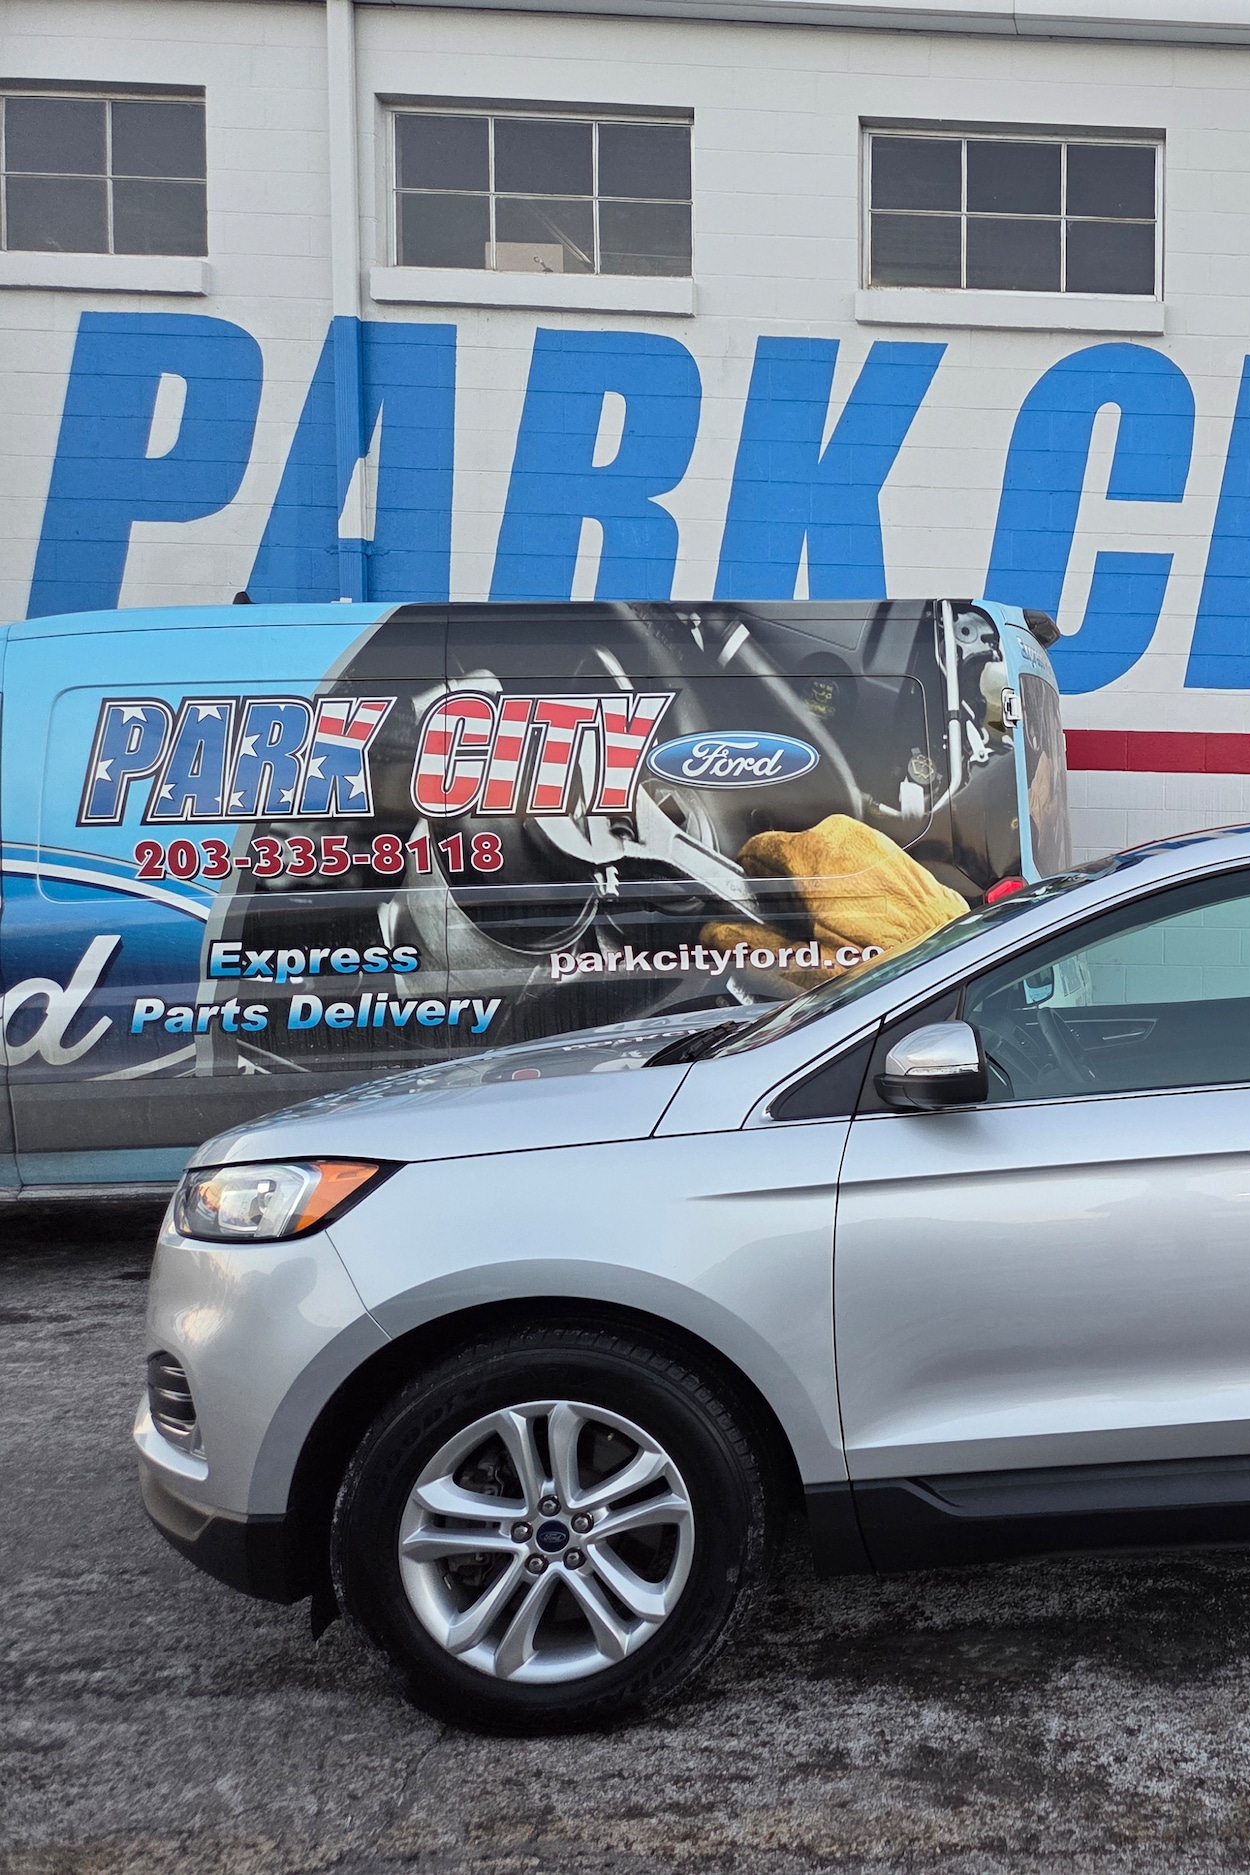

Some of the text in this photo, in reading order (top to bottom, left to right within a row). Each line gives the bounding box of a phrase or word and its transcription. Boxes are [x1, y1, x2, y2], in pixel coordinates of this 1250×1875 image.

[27, 311, 948, 619] PARK
[78, 691, 676, 826] PARK CITY
[682, 740, 785, 777] Ford
[133, 832, 505, 881] 203-335-8118
[208, 939, 420, 984] Express
[550, 941, 892, 978] parkcityford.co
[131, 992, 502, 1035] Parts Delivery
